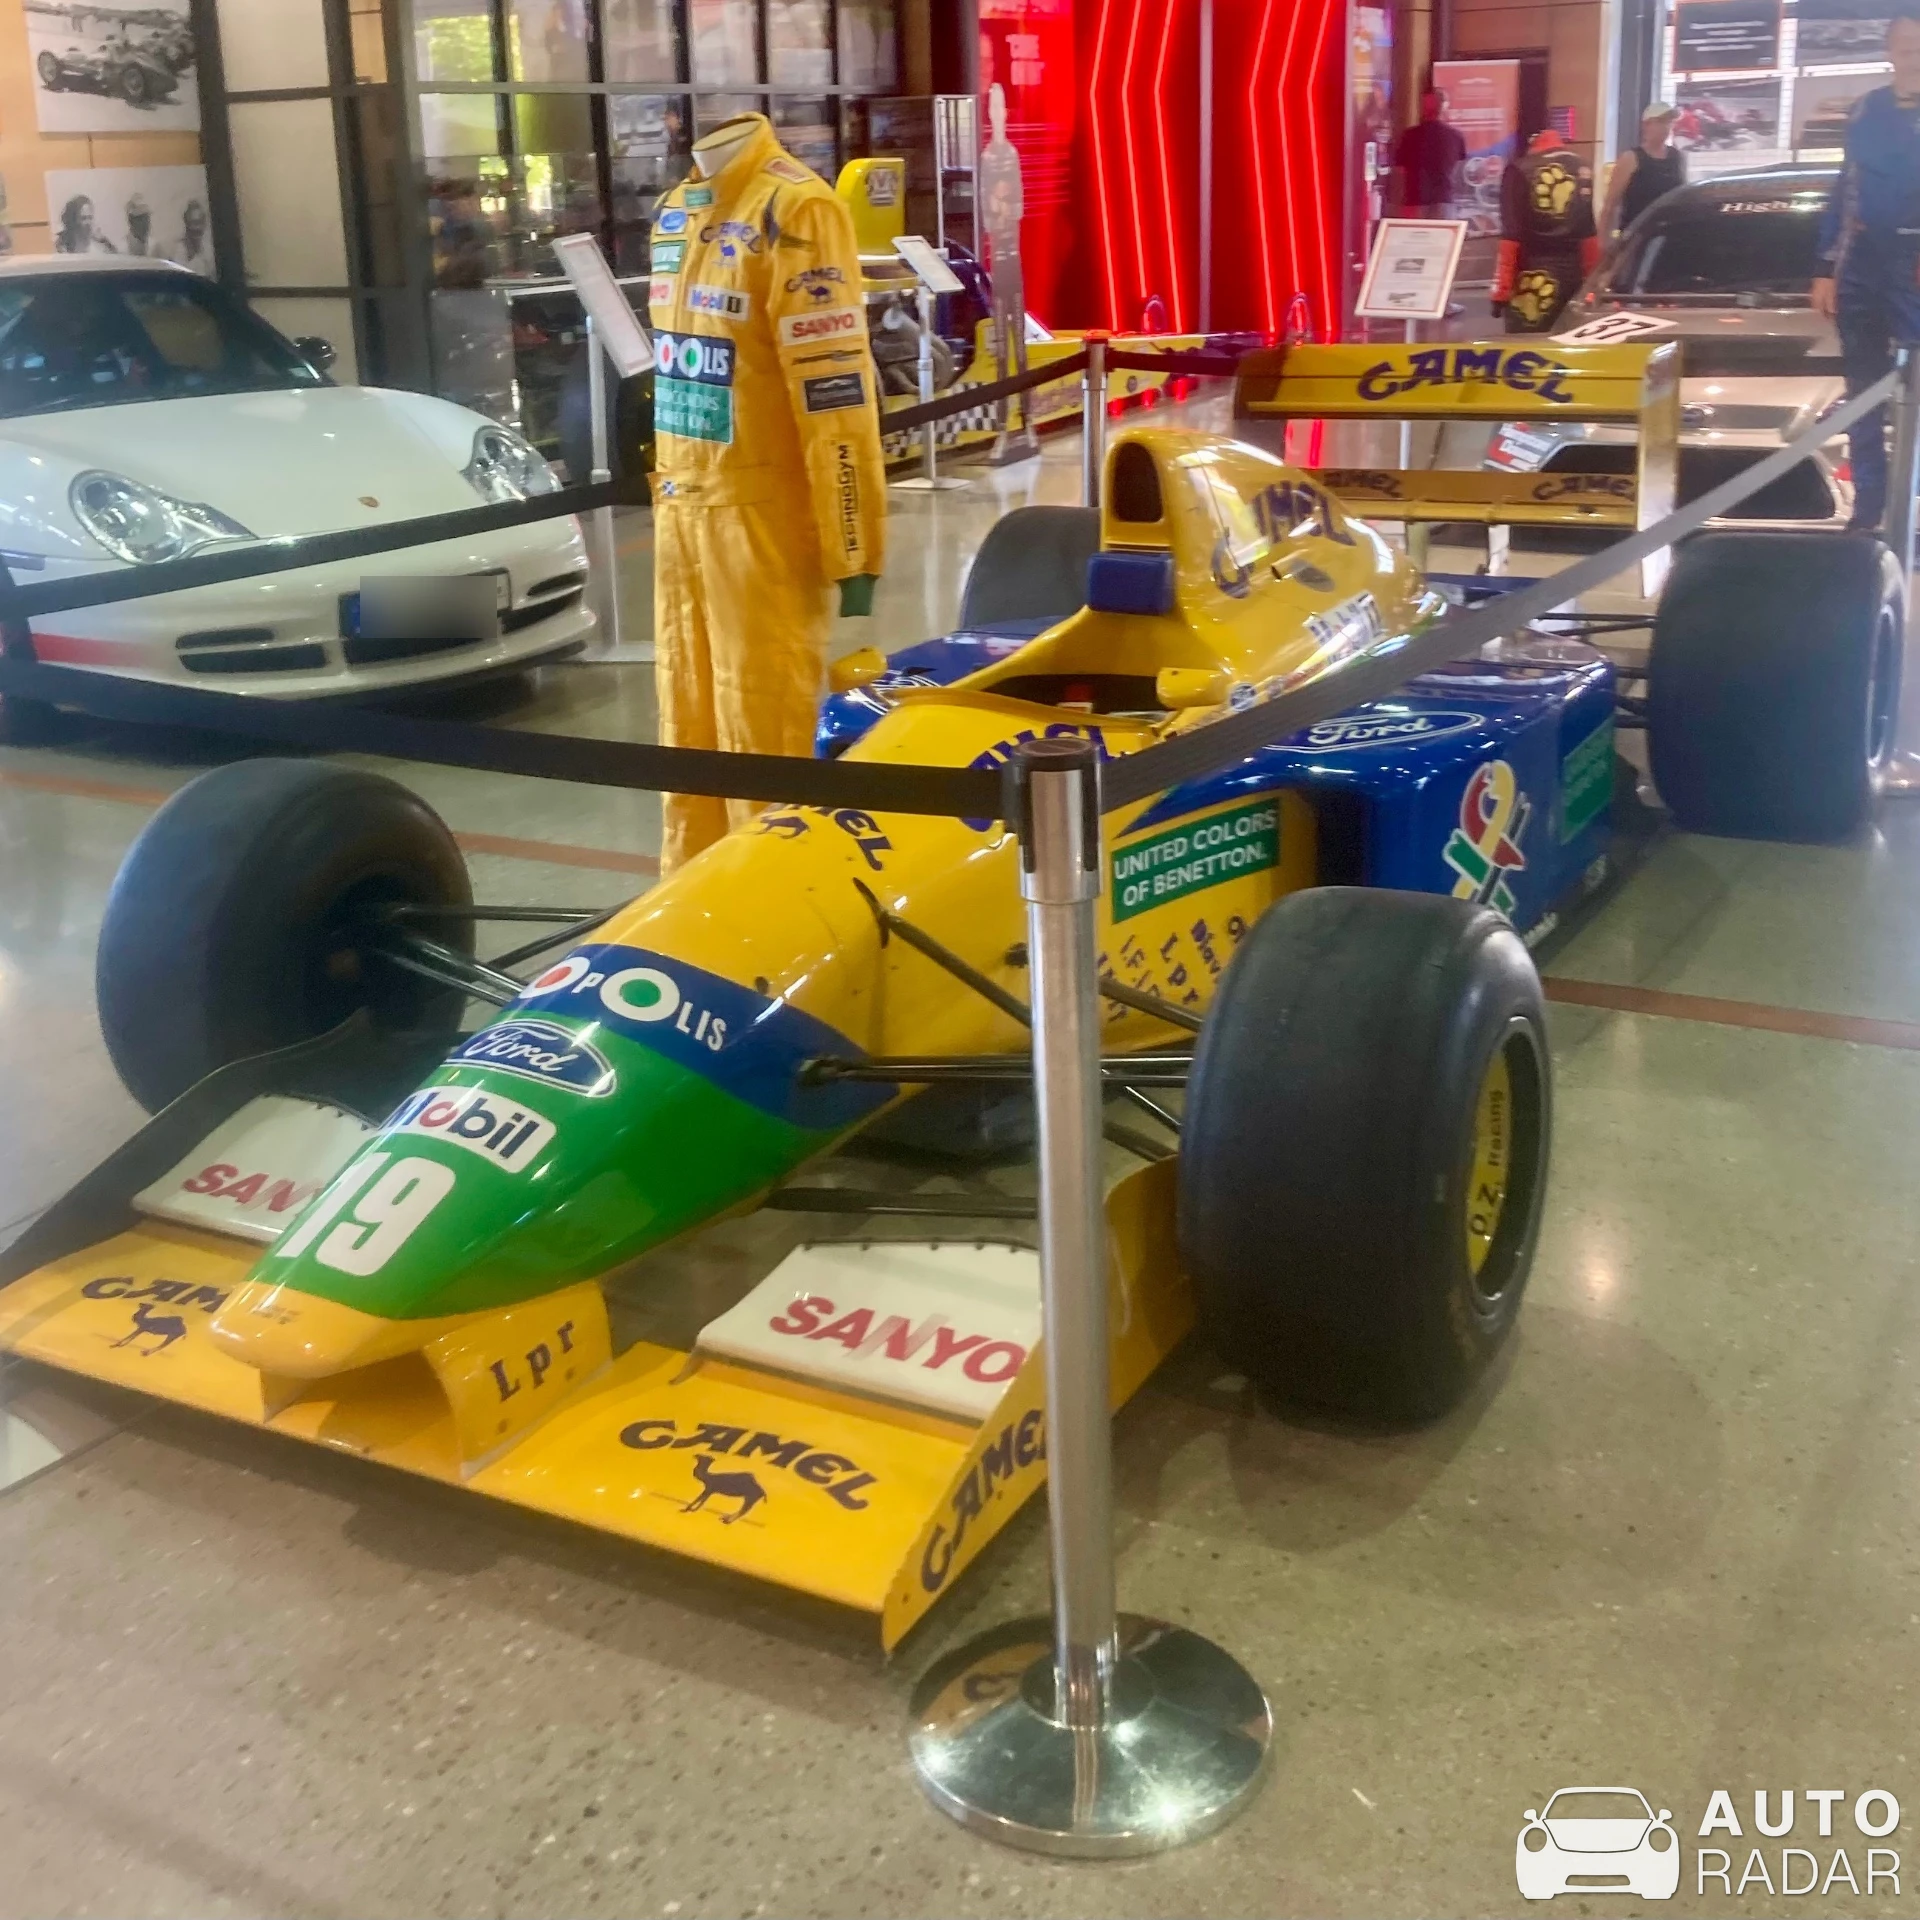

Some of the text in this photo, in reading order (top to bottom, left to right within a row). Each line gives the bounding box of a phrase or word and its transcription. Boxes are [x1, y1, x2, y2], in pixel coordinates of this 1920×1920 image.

[792, 313, 855, 338] SANYO
[1578, 317, 1657, 341] 37
[1356, 348, 1575, 403] CAMEL
[1532, 475, 1636, 501] CAME
[1307, 715, 1435, 745] Ford
[1114, 809, 1277, 880] UNITED COLORS
[1123, 880, 1149, 907] OF
[463, 1026, 580, 1073] Ford
[384, 1091, 541, 1160] Mobil
[275, 1151, 457, 1278] 19
[769, 1297, 1028, 1384] SANYO
[619, 1419, 879, 1511] CAMEL
[921, 1409, 1047, 1593] CAME
